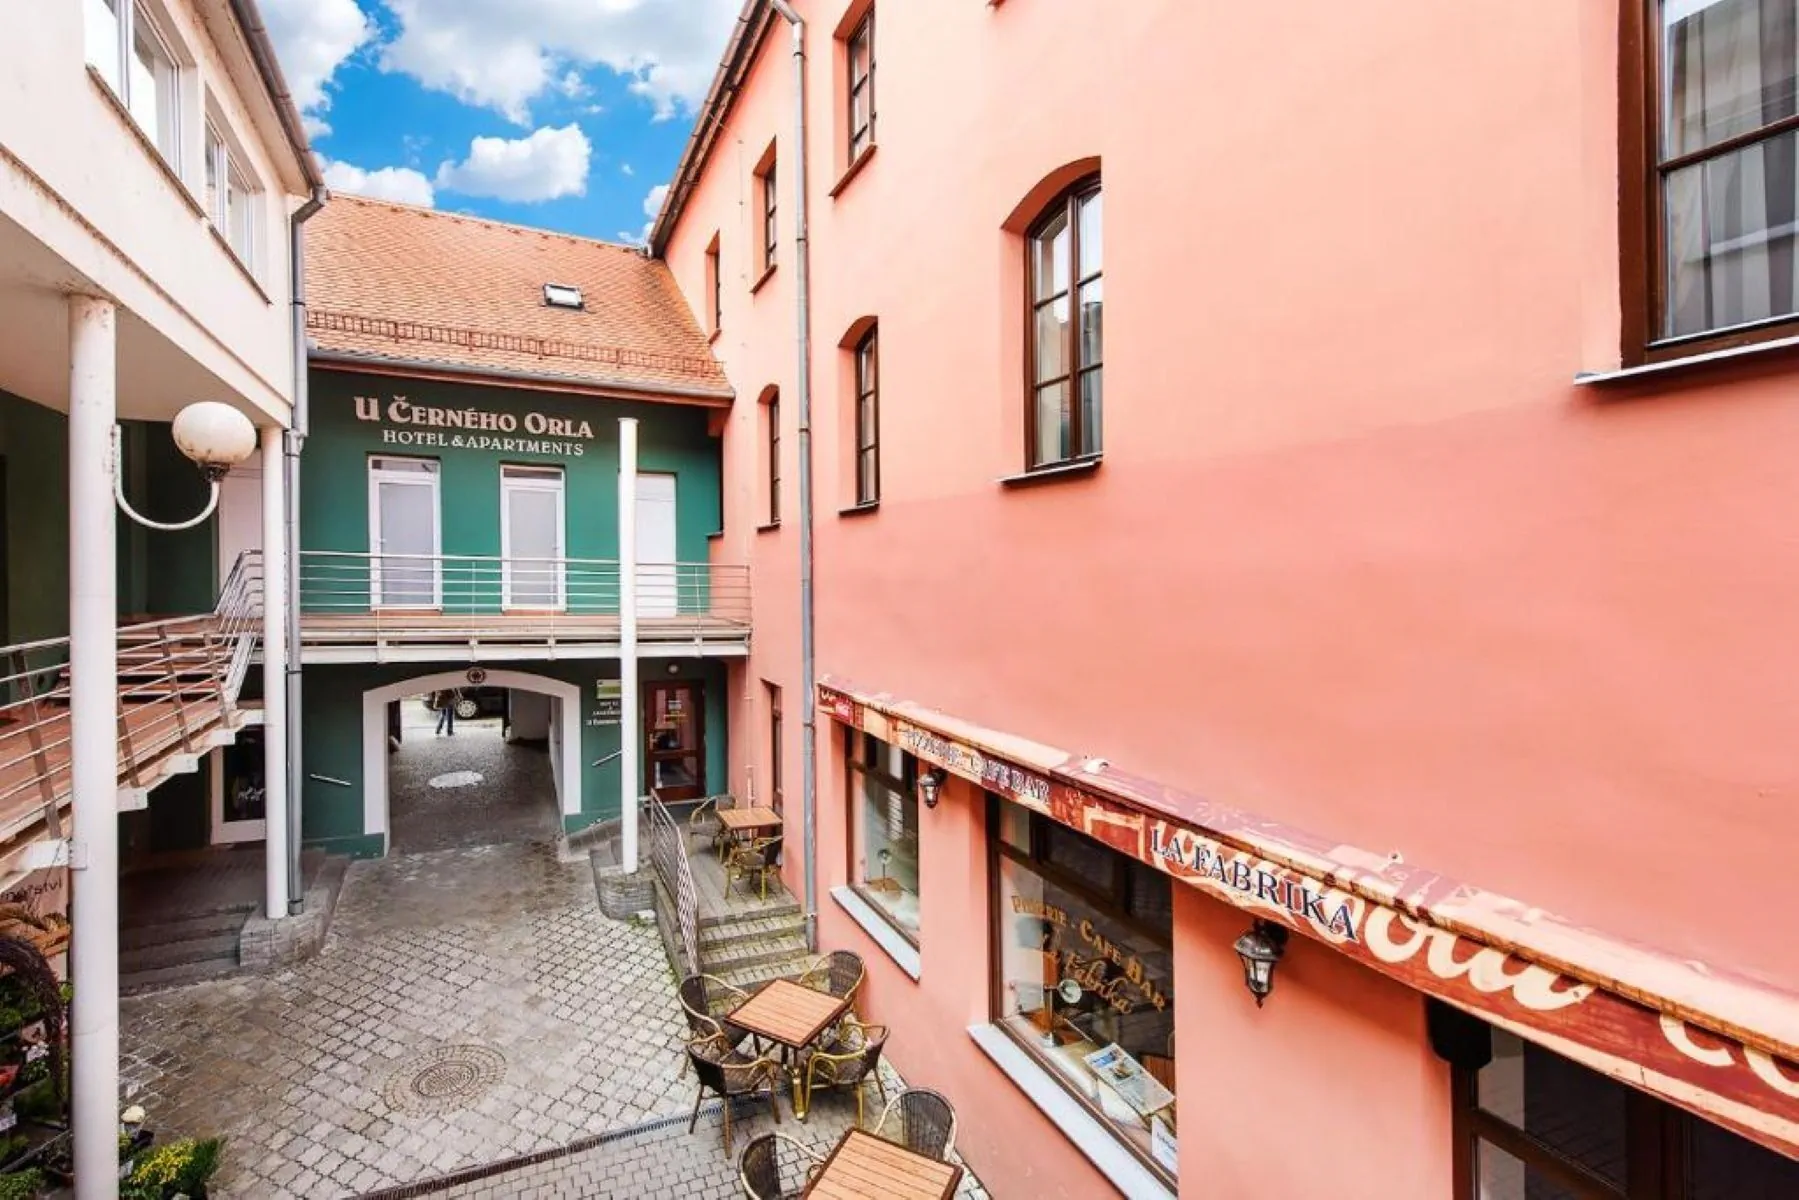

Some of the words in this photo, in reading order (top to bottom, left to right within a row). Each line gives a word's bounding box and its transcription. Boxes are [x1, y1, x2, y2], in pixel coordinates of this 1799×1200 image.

[354, 396, 380, 421] U
[524, 412, 595, 439] ORLA
[383, 429, 448, 447] HOTEL
[1151, 828, 1185, 865] LA
[1193, 844, 1360, 944] FABRIKA
